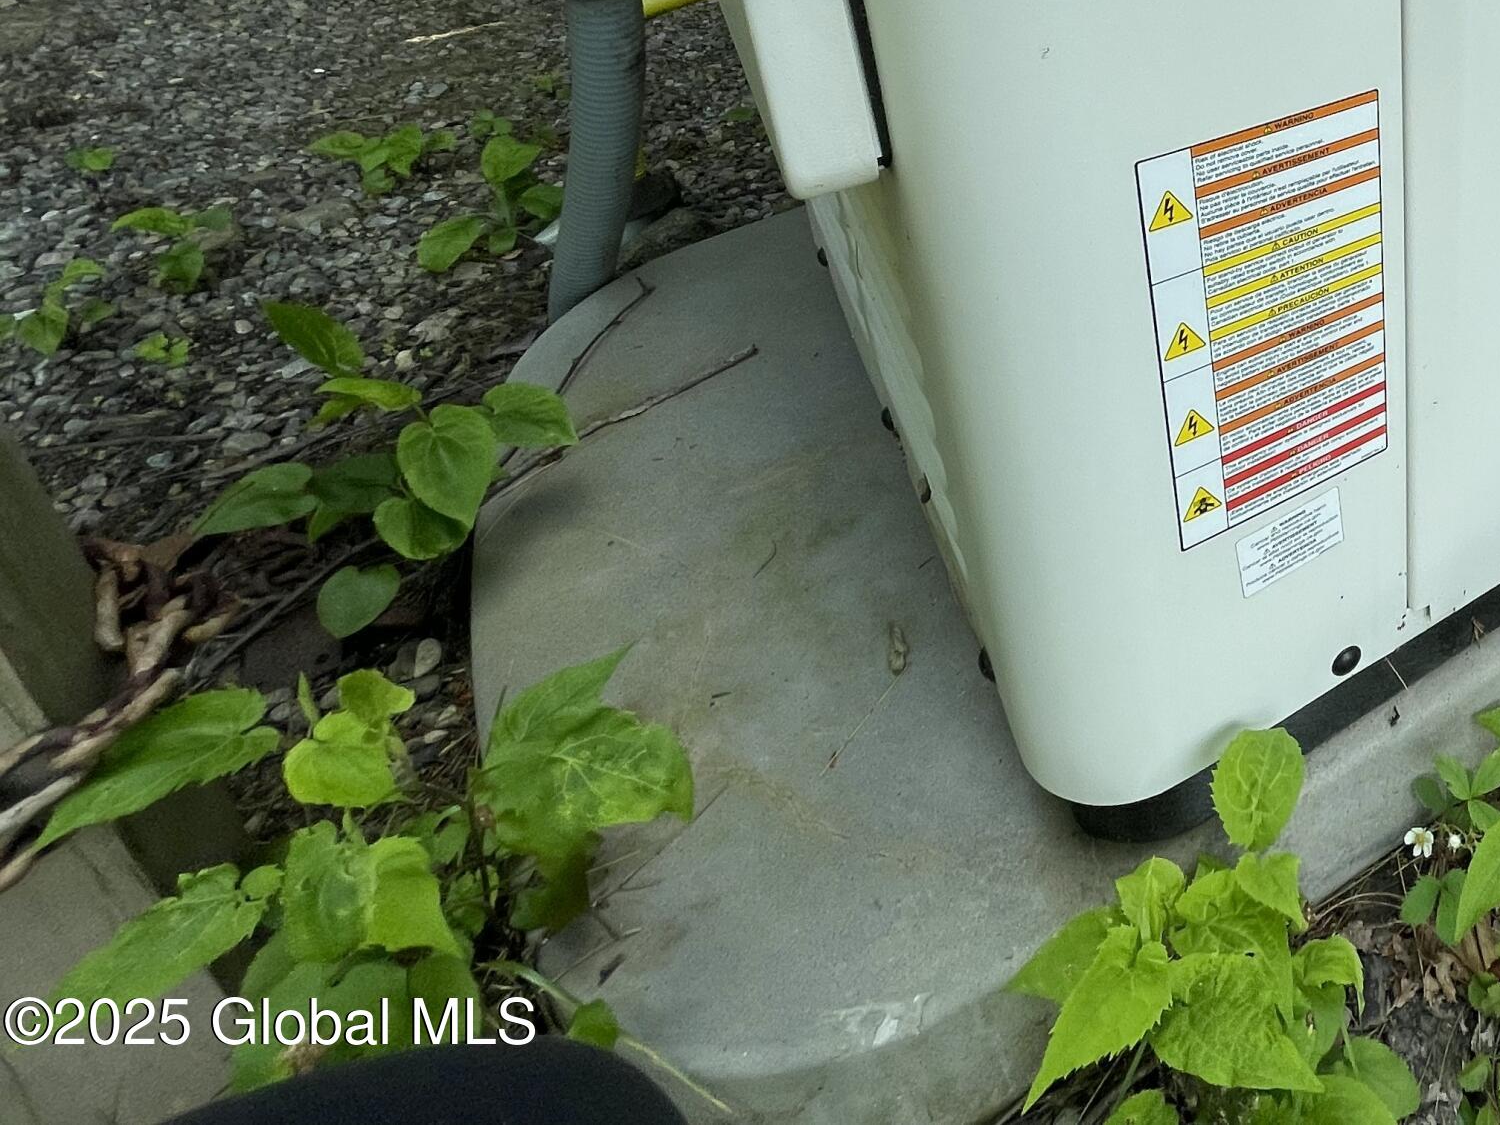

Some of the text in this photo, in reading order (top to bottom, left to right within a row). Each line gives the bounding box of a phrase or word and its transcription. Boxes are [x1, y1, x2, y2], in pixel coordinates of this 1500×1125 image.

[1275, 113, 1313, 130] WARNING
[1262, 147, 1330, 176] AVERTISSEMENT
[1270, 186, 1327, 213] ADVERTENCIA
[1283, 227, 1318, 246] CAUTION
[1280, 256, 1323, 279] ATTENTION
